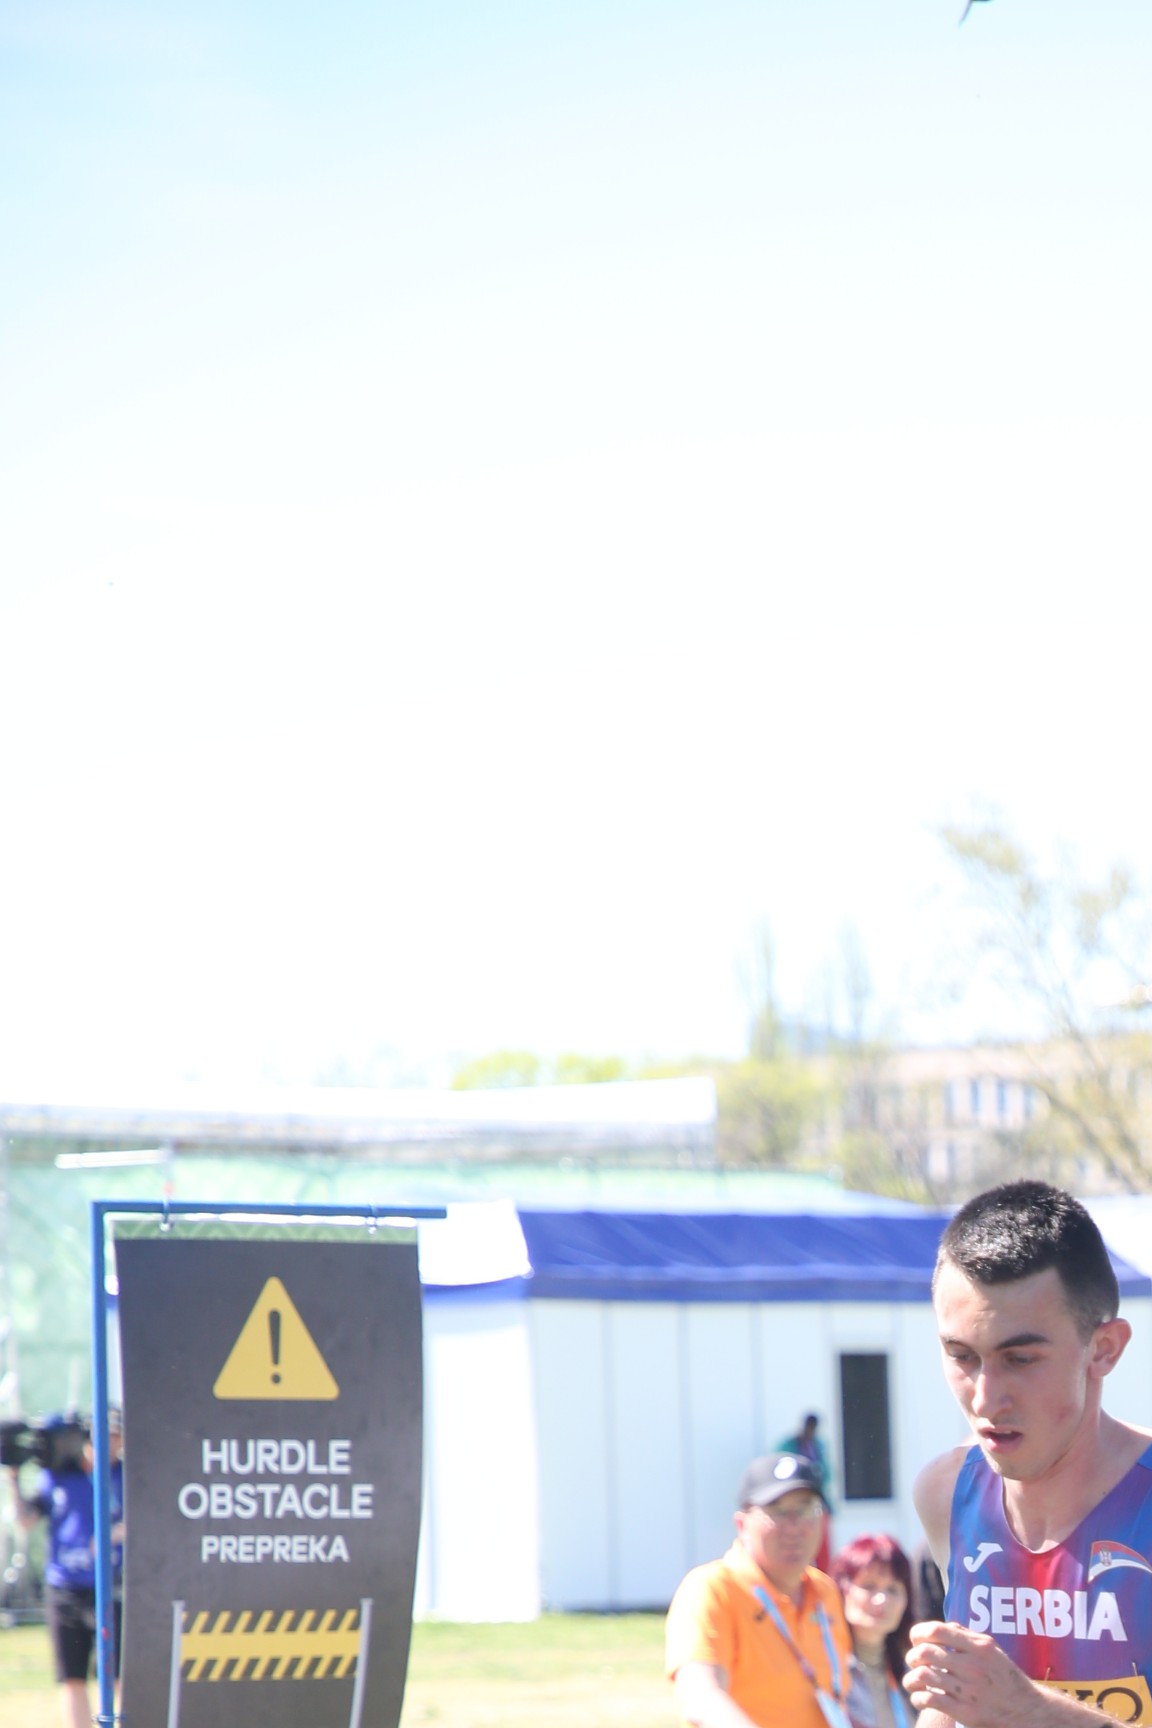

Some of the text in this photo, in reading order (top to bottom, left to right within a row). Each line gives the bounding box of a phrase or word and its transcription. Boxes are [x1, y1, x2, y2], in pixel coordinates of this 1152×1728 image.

[202, 1438, 352, 1475] HURDLE
[177, 1482, 375, 1519] OBSTACLE
[201, 1534, 350, 1563] PREPREKA
[968, 1584, 1129, 1642] SERBIA
